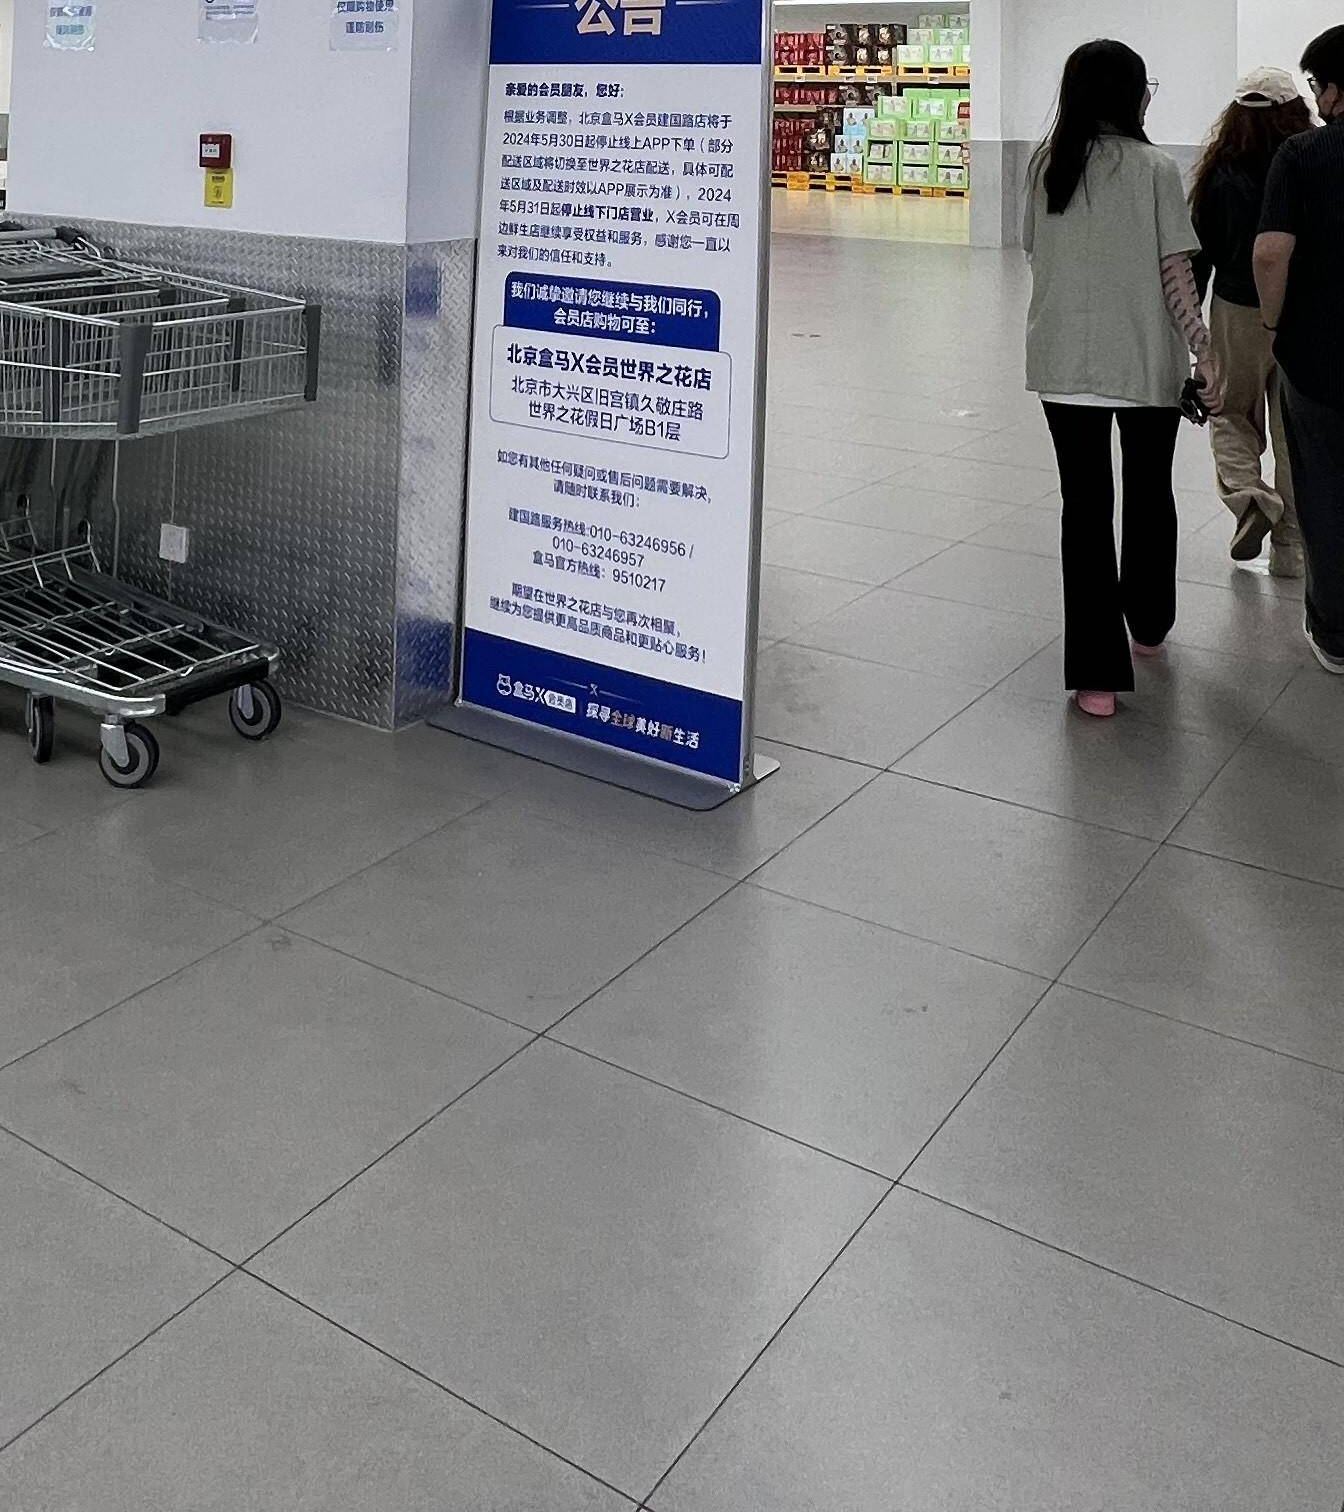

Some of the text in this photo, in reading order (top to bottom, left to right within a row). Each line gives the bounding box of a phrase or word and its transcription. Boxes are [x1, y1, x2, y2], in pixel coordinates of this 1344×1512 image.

[507, 343, 712, 391] 北京盒马X会员世界之花店
[512, 375, 704, 421] 北京市大兴区旧宫镇久敬庄路
[529, 400, 681, 442] 世界之花假日广场B1层
[552, 535, 645, 568] 010-63246957
